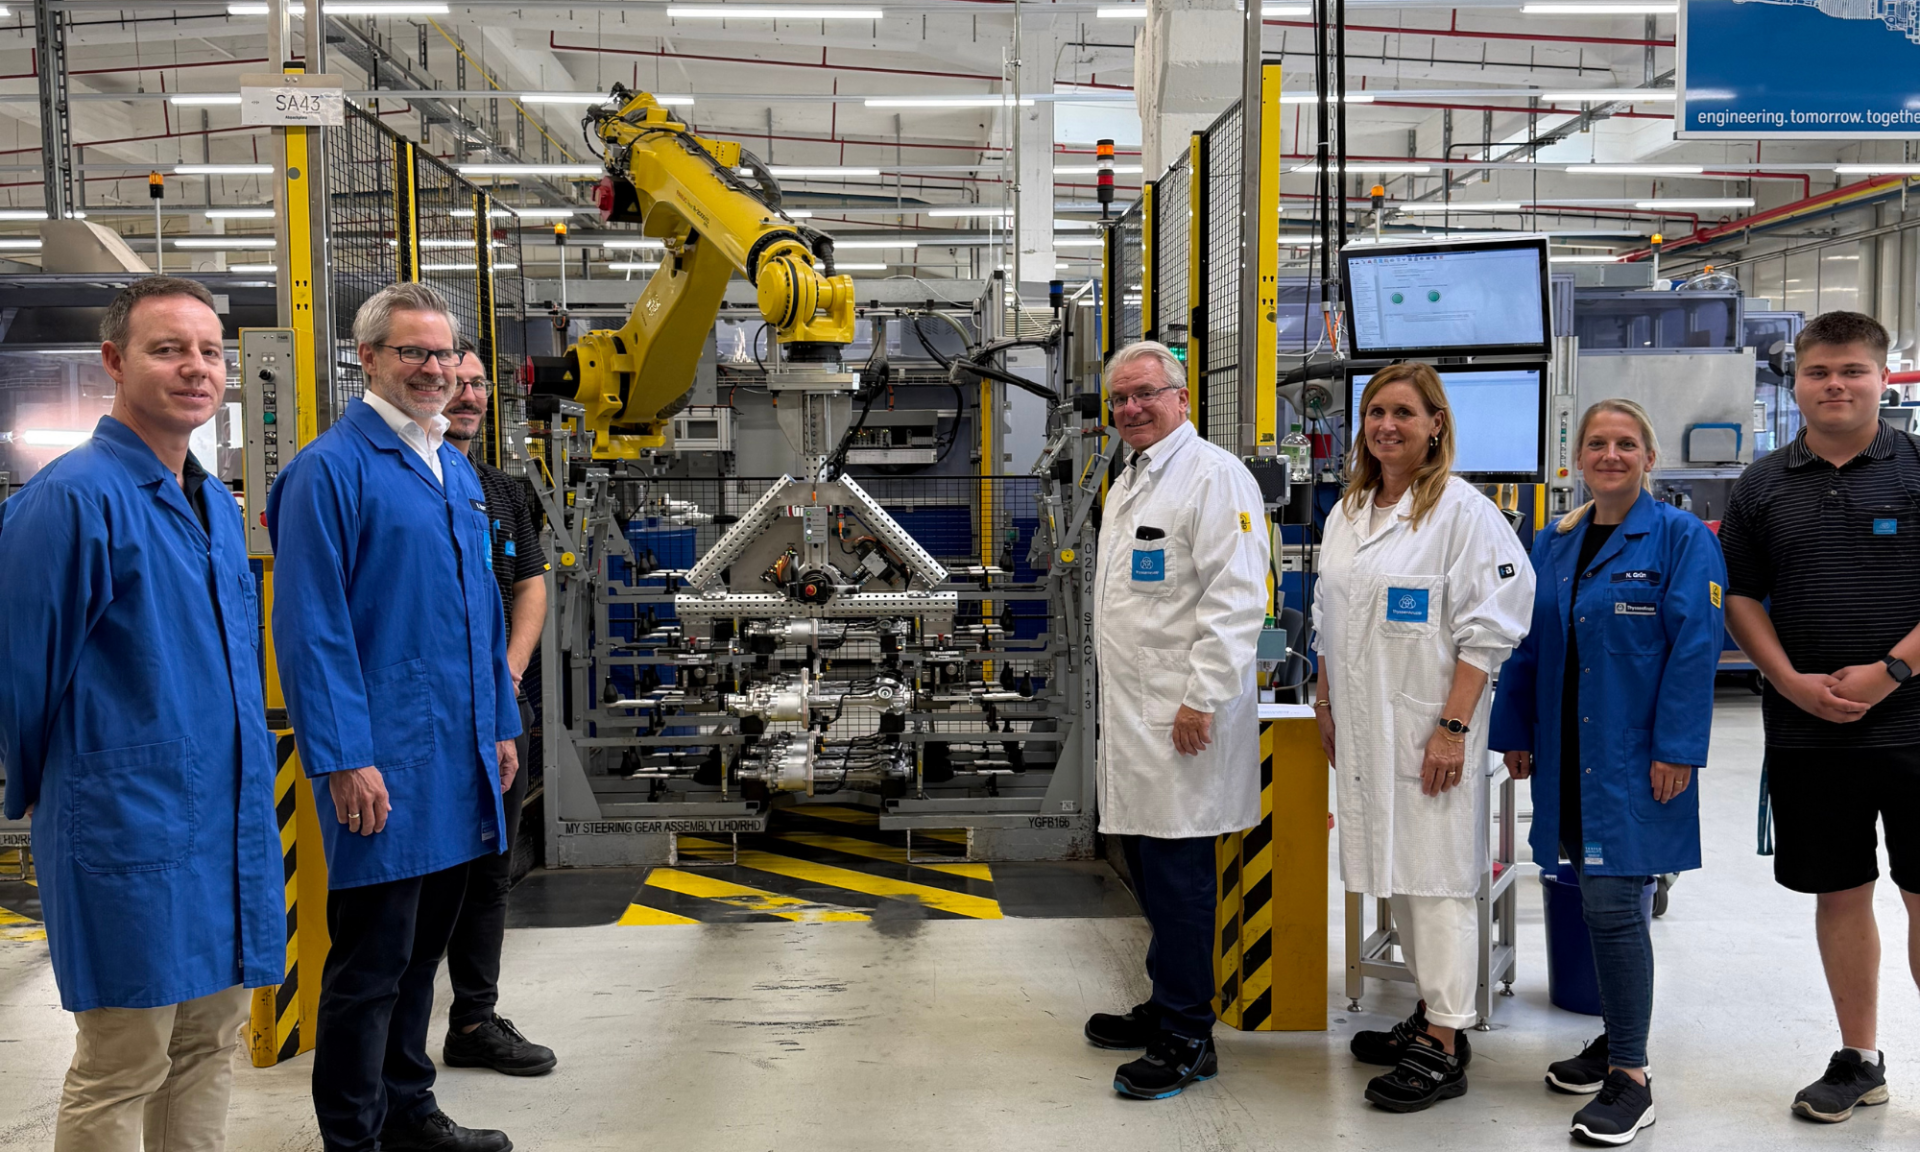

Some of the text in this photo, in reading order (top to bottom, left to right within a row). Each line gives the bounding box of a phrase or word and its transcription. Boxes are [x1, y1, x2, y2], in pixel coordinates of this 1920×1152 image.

[275, 94, 321, 112] SA43
[1697, 108, 1920, 127] engineering. tomorrow. togethe
[1083, 543, 1092, 710] 0204 STACK 1+3
[565, 820, 761, 834] MY STEERING GEAR ASSEMBLY LHD/RHD
